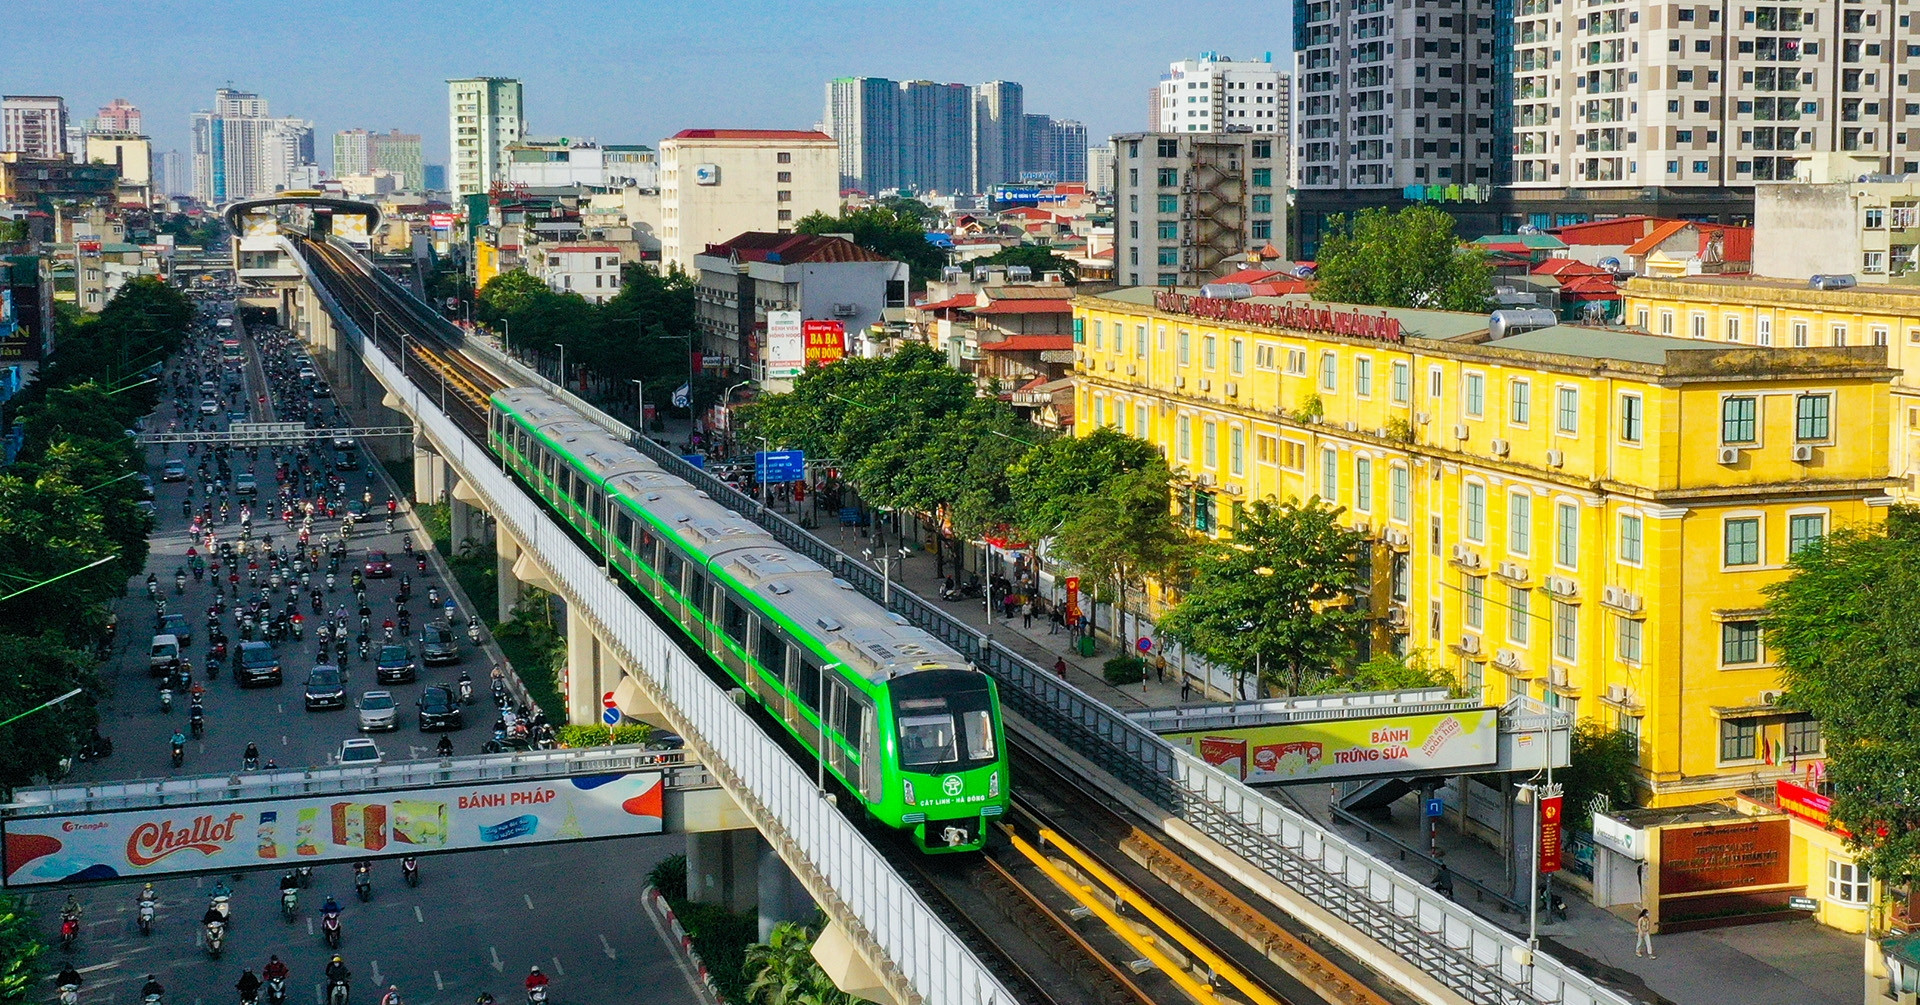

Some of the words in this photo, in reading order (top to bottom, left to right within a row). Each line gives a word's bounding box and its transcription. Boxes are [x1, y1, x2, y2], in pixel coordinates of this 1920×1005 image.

[810, 333, 823, 344] BA
[825, 333, 838, 344] BA
[1371, 728, 1409, 744] BÁNH
[1334, 748, 1379, 764] TRỨNG
[1382, 744, 1409, 760] SỮA
[458, 791, 507, 809] BÁNH
[510, 787, 556, 805] PHÁP
[127, 812, 244, 866] Challot
